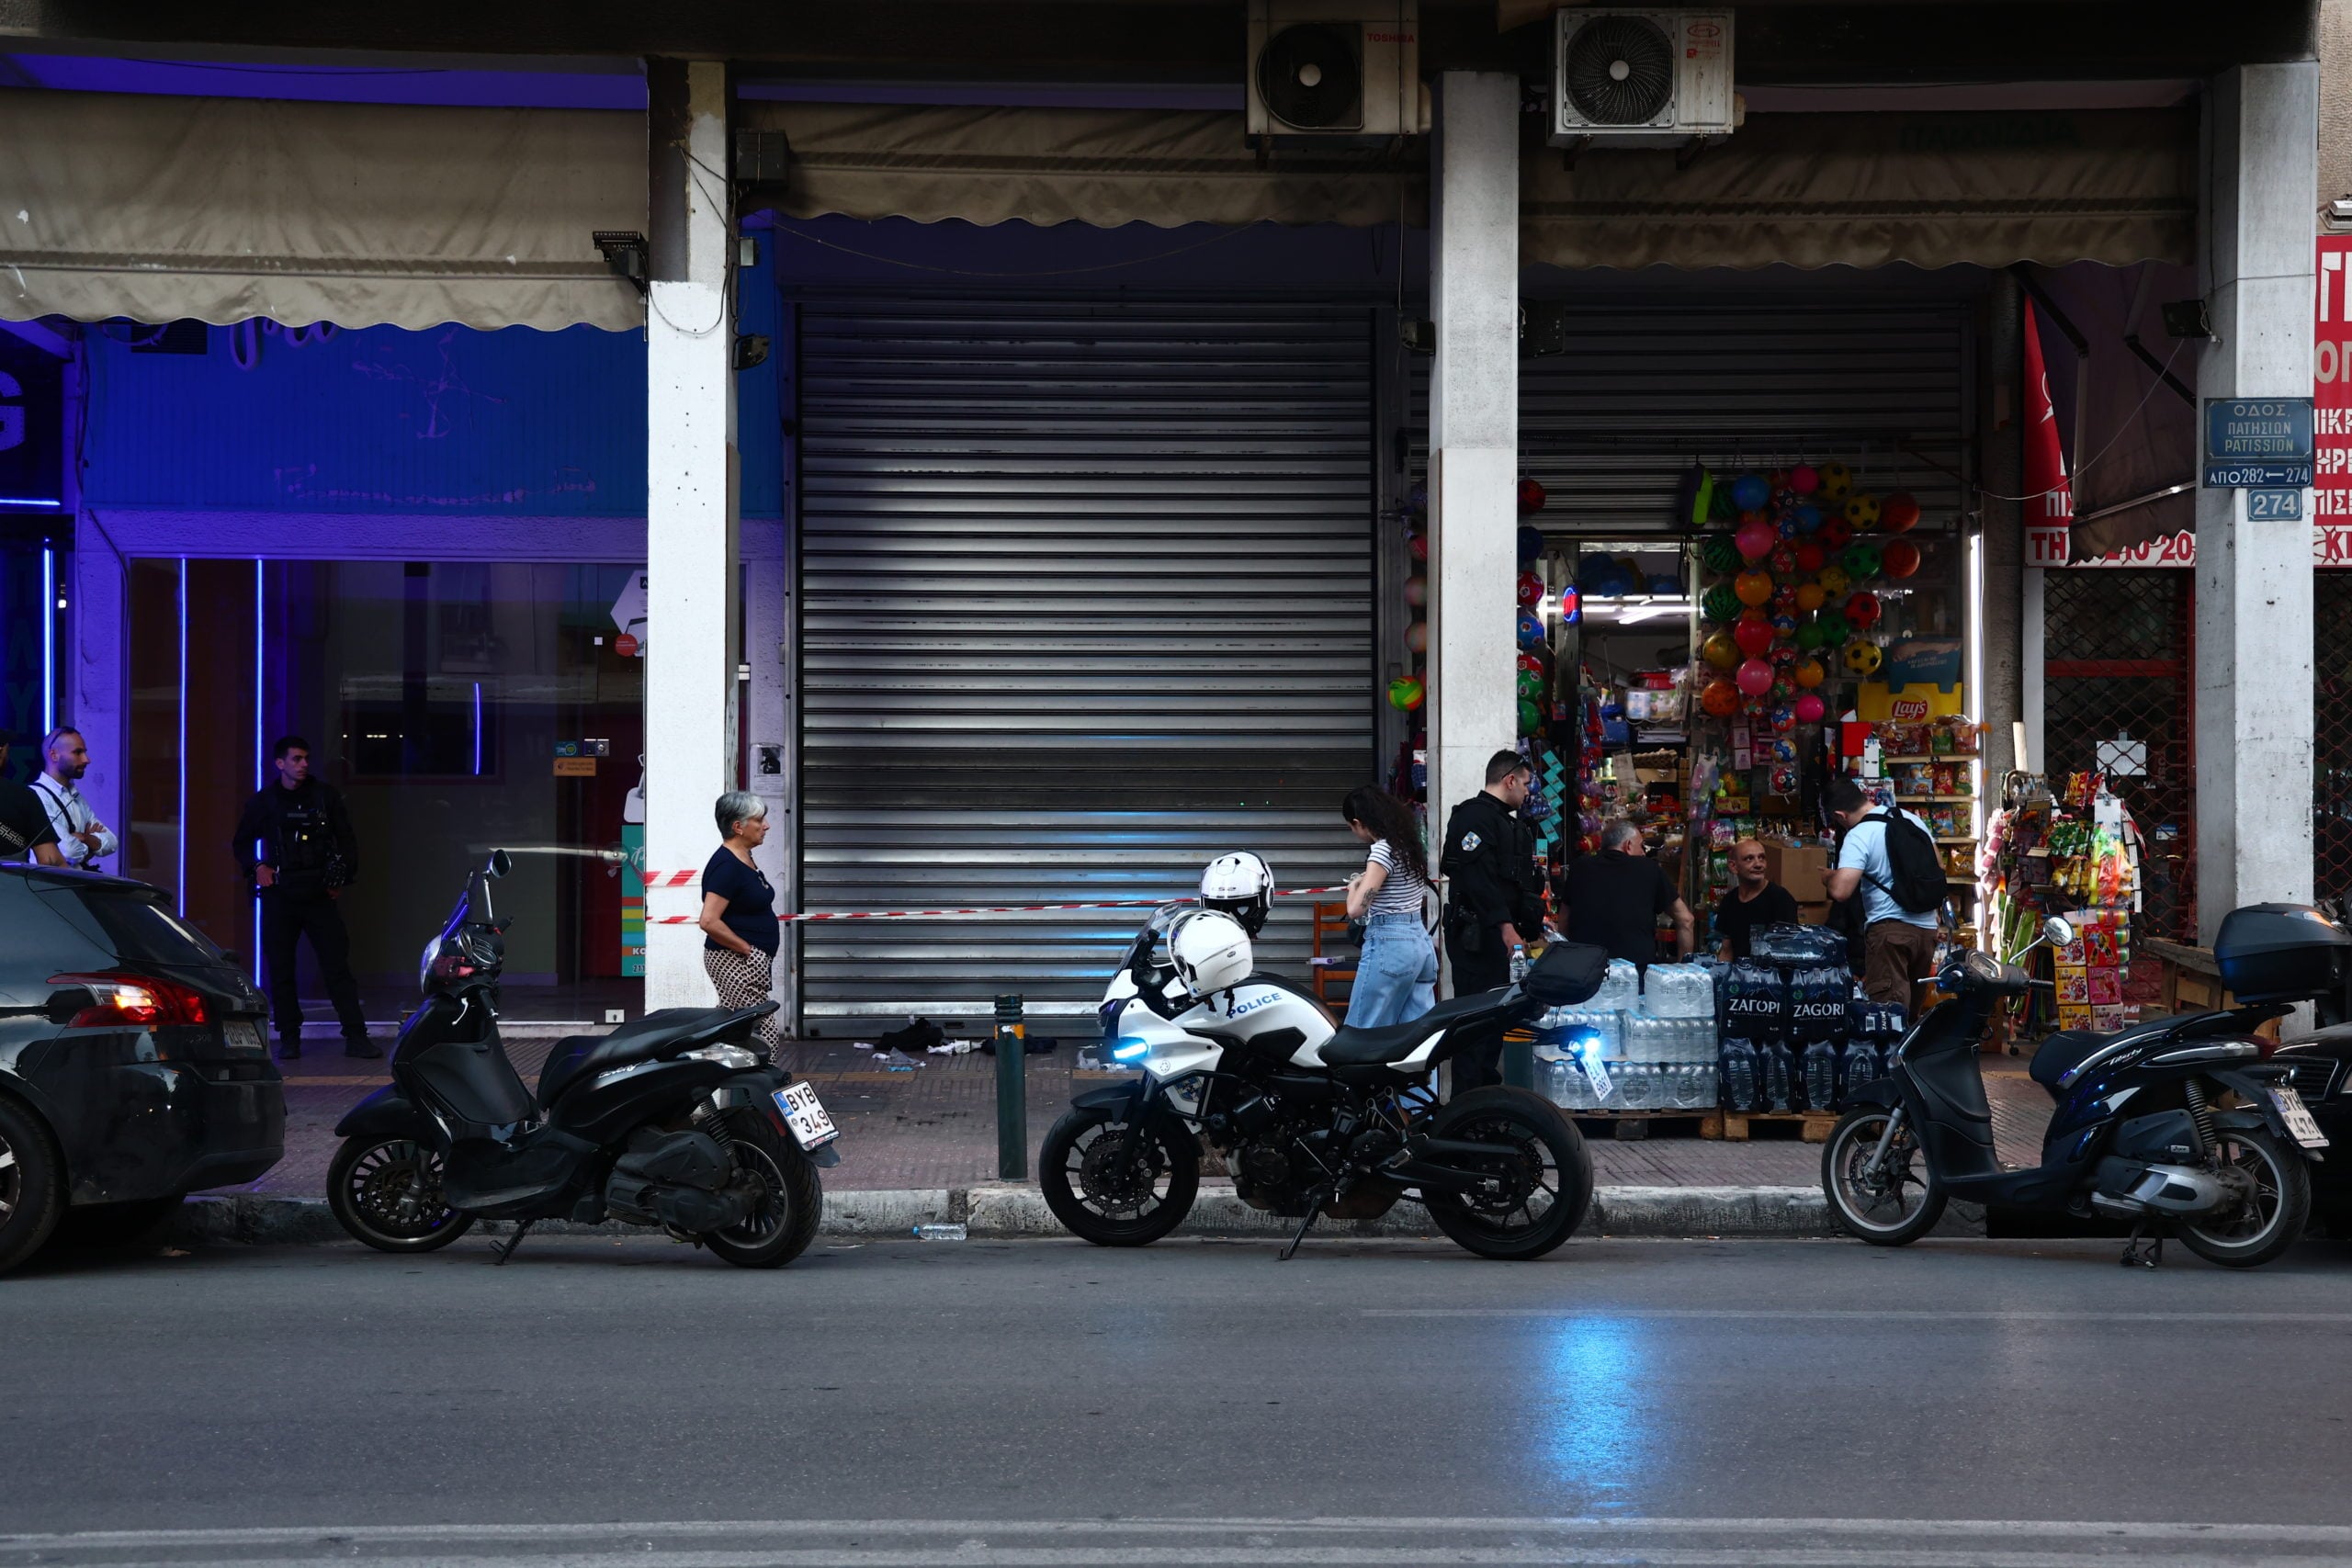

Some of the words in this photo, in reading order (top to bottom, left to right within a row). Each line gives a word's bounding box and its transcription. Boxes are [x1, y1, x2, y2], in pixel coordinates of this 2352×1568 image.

[1367, 33, 1415, 42] TOSHIBA
[2234, 404, 2286, 416] ΟΔΟΣ
[2228, 422, 2291, 434] ΠΑΤΗΣΙΩΝ
[2225, 439, 2294, 452] PATISSION
[2242, 468, 2264, 483] 282
[2286, 467, 2308, 482] 274
[2254, 494, 2297, 514] 274
[2030, 532, 2066, 560] ΤΗ
[1894, 700, 1927, 719] Lay's
[1227, 993, 1282, 1018] POLICE
[1728, 998, 1781, 1014] ΖΑΓΟΡΙ
[1793, 1002, 1845, 1018] ZAGORI
[786, 1087, 816, 1111] BYB
[800, 1110, 830, 1134] 349
